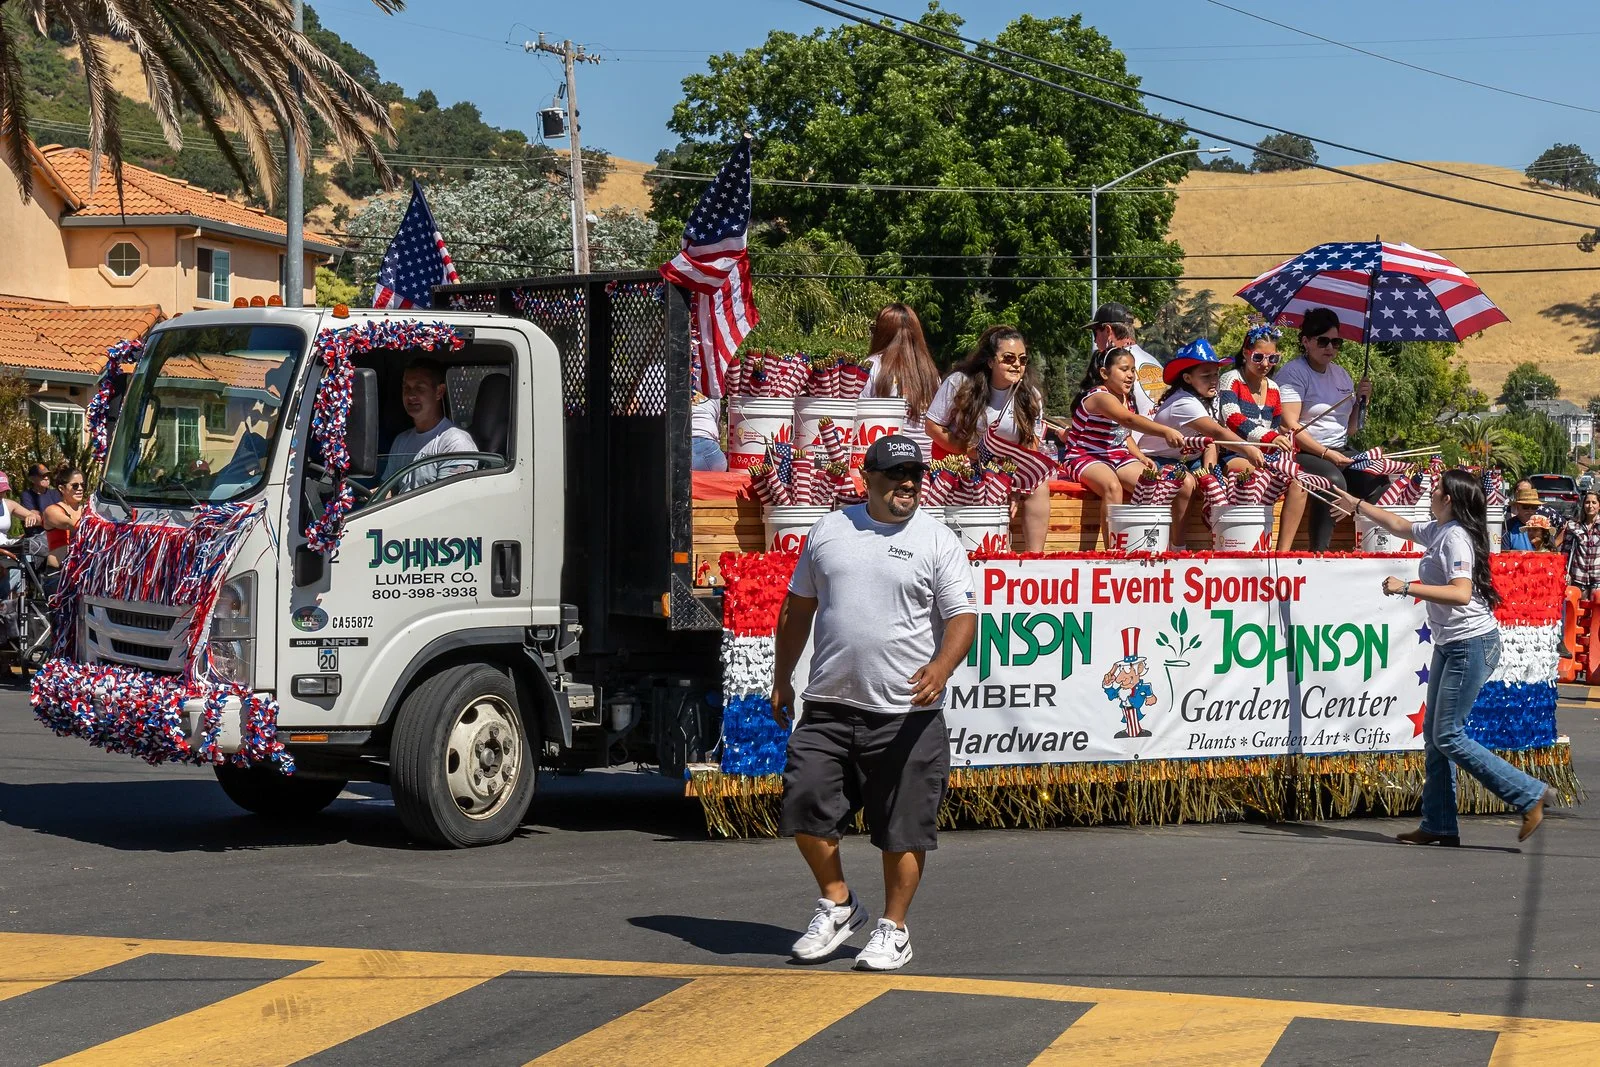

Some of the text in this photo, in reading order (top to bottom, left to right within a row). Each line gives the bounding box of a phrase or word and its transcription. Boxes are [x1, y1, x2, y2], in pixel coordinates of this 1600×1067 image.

[366, 528, 483, 573] JOHNSON
[375, 572, 478, 586] LUMBER CO.
[984, 566, 1307, 610] Proud Event Sponsor
[372, 586, 478, 600] 800-398-3938
[332, 615, 374, 629] CA55872
[322, 638, 359, 646] NRR
[967, 611, 1093, 683] NSON
[1210, 609, 1389, 686] JOHNSON
[320, 654, 337, 670] 20
[950, 683, 1057, 710] MBER
[1180, 685, 1398, 723] Garden Center
[947, 726, 1090, 755] Hardware
[1187, 726, 1391, 750] Plants Garden Art Gifts
